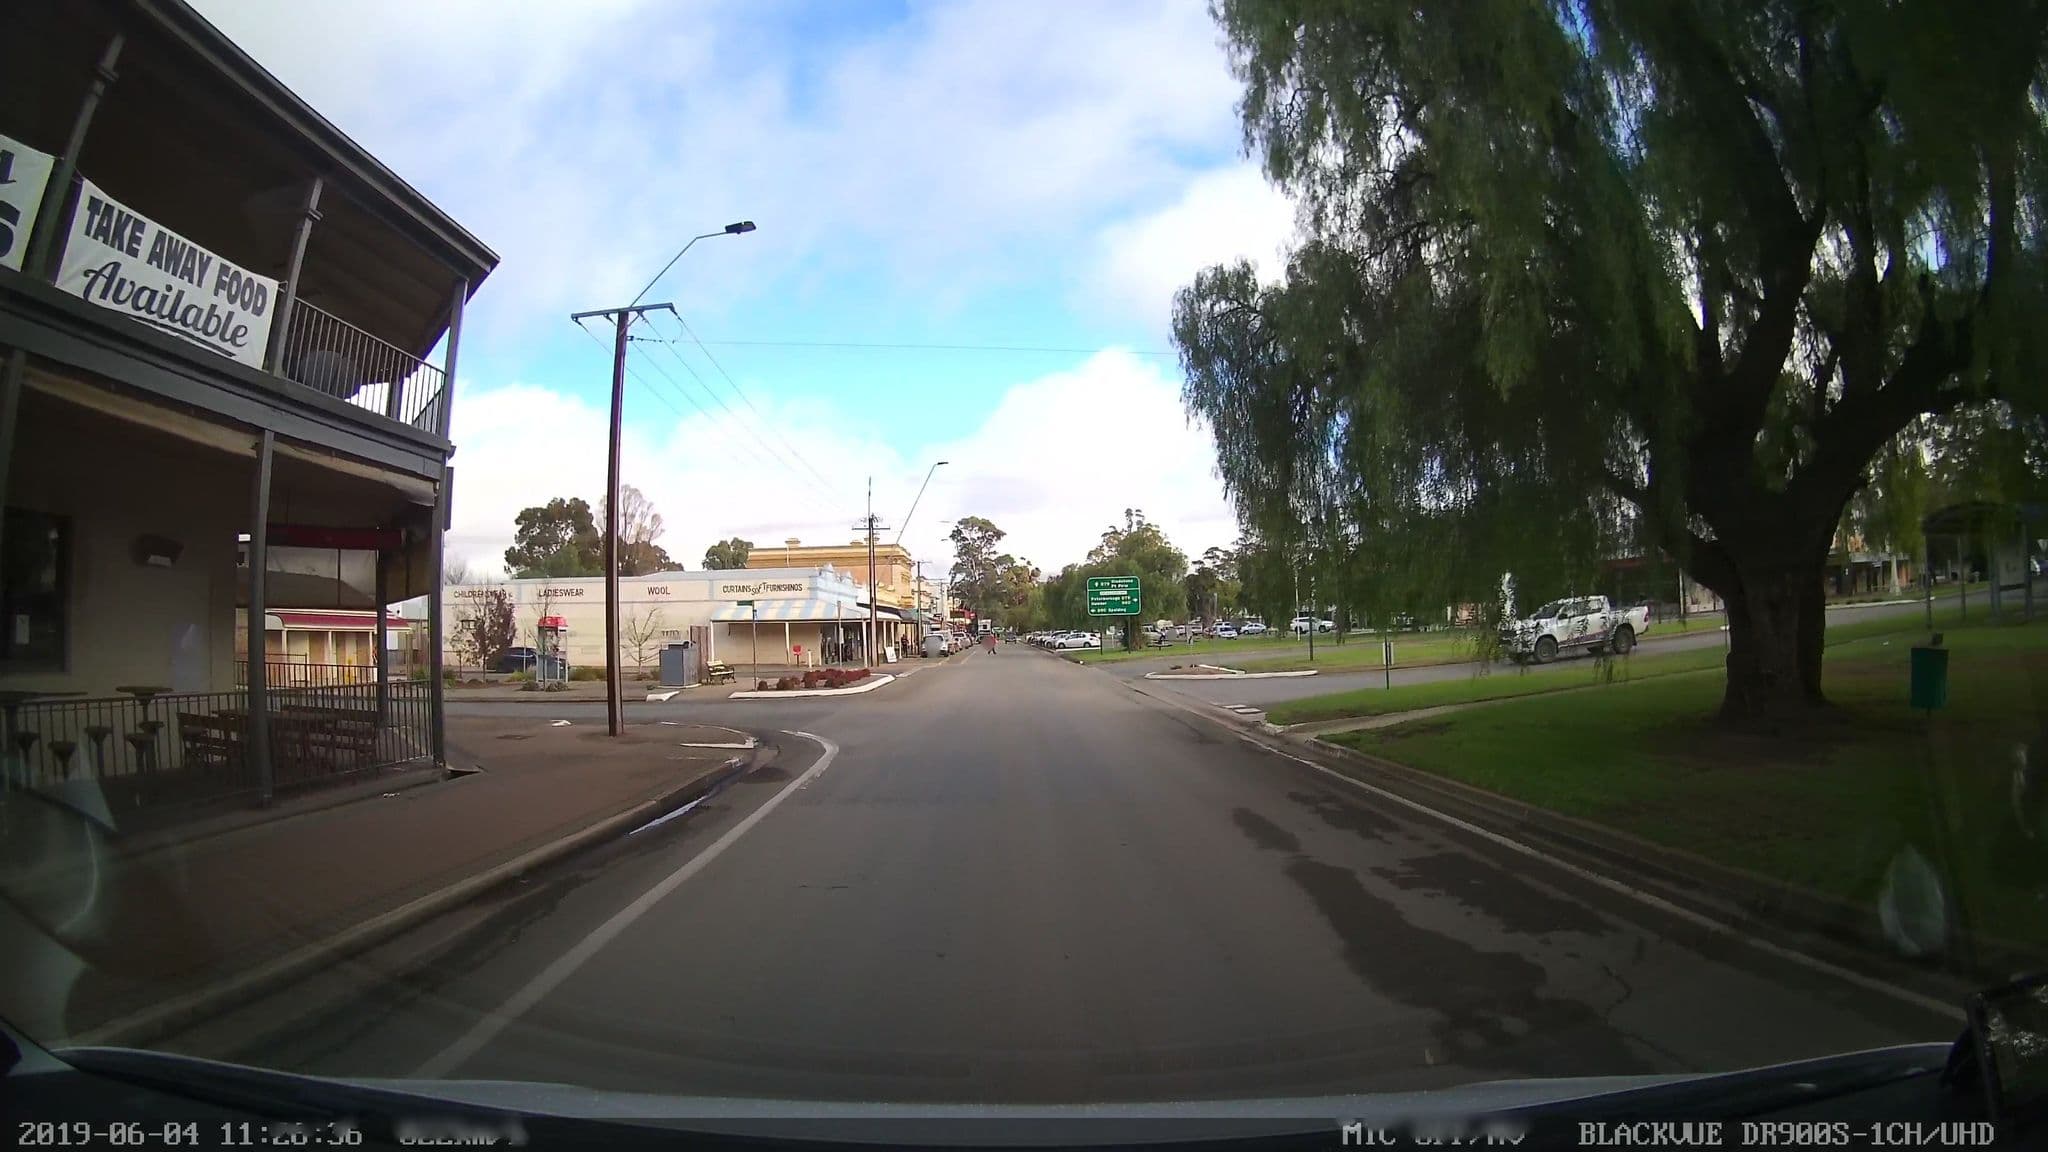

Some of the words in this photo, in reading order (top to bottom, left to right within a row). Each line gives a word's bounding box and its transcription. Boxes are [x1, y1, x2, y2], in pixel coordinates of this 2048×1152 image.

[84, 195, 146, 259] TAKE
[146, 229, 212, 288] AWAY
[213, 264, 268, 317] FOOD
[84, 261, 248, 348] Available
[538, 588, 584, 598] LADIESWEAR
[647, 586, 671, 595] WOOL
[722, 584, 751, 594] CURTAINS
[766, 583, 803, 592] FURNISHINGS
